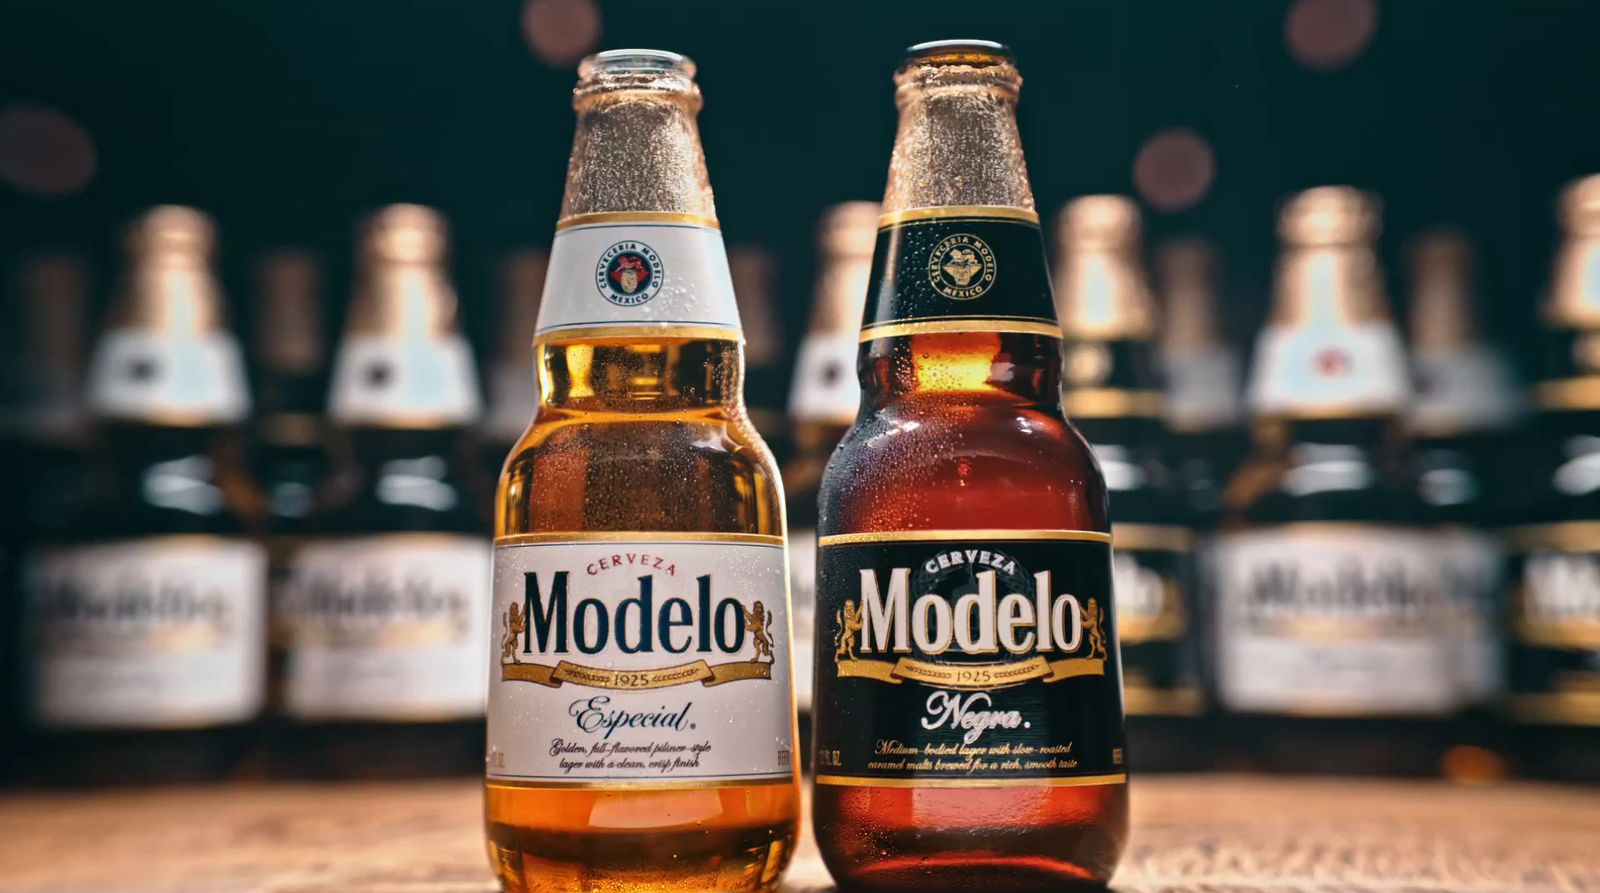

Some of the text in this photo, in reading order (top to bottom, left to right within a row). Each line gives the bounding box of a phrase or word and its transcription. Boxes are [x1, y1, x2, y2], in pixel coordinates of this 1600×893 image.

[598, 243, 662, 289] CERVECERIA MODELO
[973, 241, 995, 281] MODELO
[609, 292, 649, 304] MEXICO
[943, 286, 983, 298] MEXICO
[586, 552, 677, 576] CERVEZA
[925, 549, 1018, 576] CERVEZA
[522, 570, 746, 655] Modelo
[859, 567, 1084, 655] Modelo
[613, 673, 650, 687] 1925
[955, 669, 992, 683] 1925
[549, 738, 588, 757] Golden,
[958, 741, 988, 764] lager
[988, 742, 1011, 755] with
[559, 756, 701, 774] lager with a clean, crisp finish
[867, 758, 906, 770] caramel
[906, 758, 933, 771] malts
[934, 758, 973, 771] brewed
[966, 758, 990, 776] for
[989, 761, 999, 771] a
